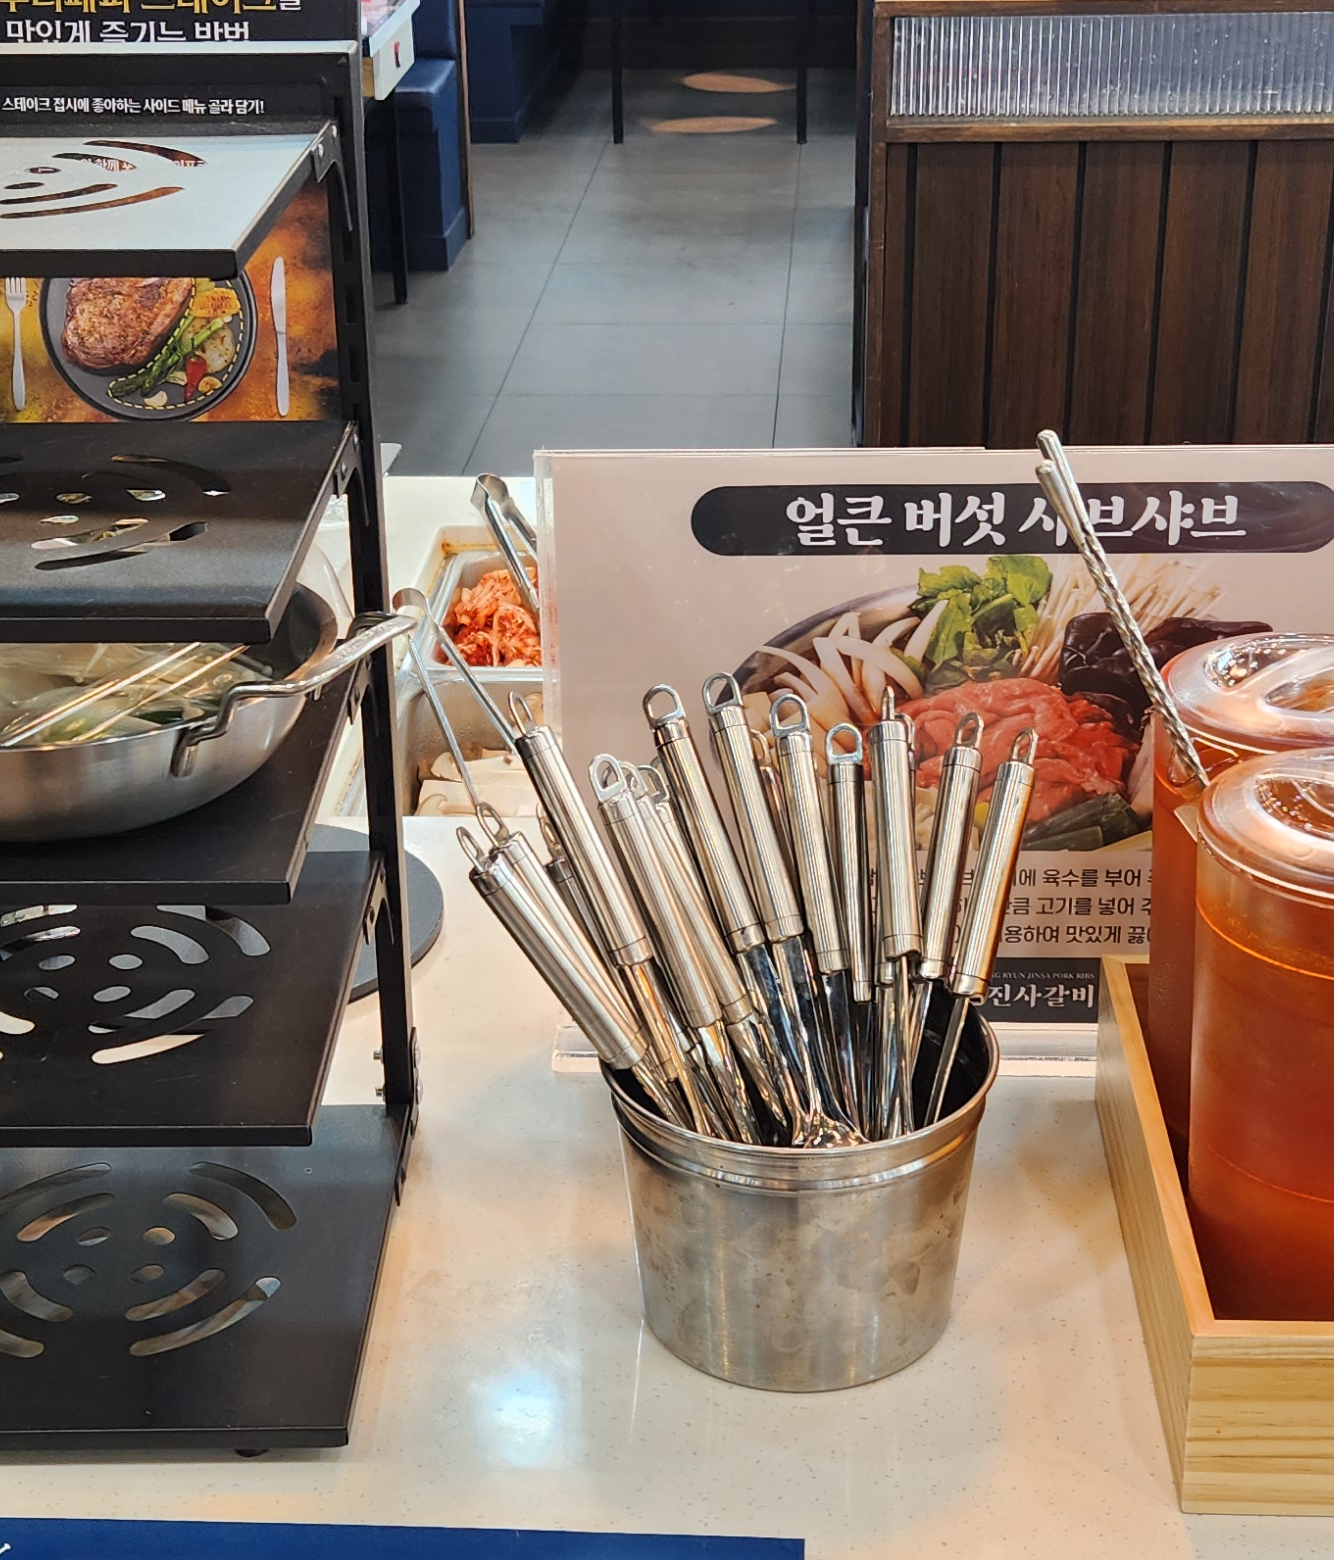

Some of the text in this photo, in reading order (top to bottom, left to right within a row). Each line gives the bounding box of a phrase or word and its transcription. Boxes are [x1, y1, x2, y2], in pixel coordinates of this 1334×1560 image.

[1, 97, 52, 112] 스테이크
[53, 97, 90, 113] 접시에
[91, 98, 142, 114] 좋아하는
[143, 98, 181, 114] 사이드
[181, 99, 207, 114] 메뉴
[208, 99, 234, 115] 골라
[235, 99, 265, 115] 담기!
[786, 492, 893, 547] 얼큰
[904, 491, 1007, 547] 버섯
[1041, 868, 1099, 888] 육수를
[1104, 869, 1142, 888] 부어
[1035, 897, 1093, 916] 고기를
[1098, 897, 1135, 916] 넣어
[1003, 925, 1060, 944] 용하여
[1065, 925, 1122, 944] 맛있게
[987, 983, 1095, 1009] 진사갈비
